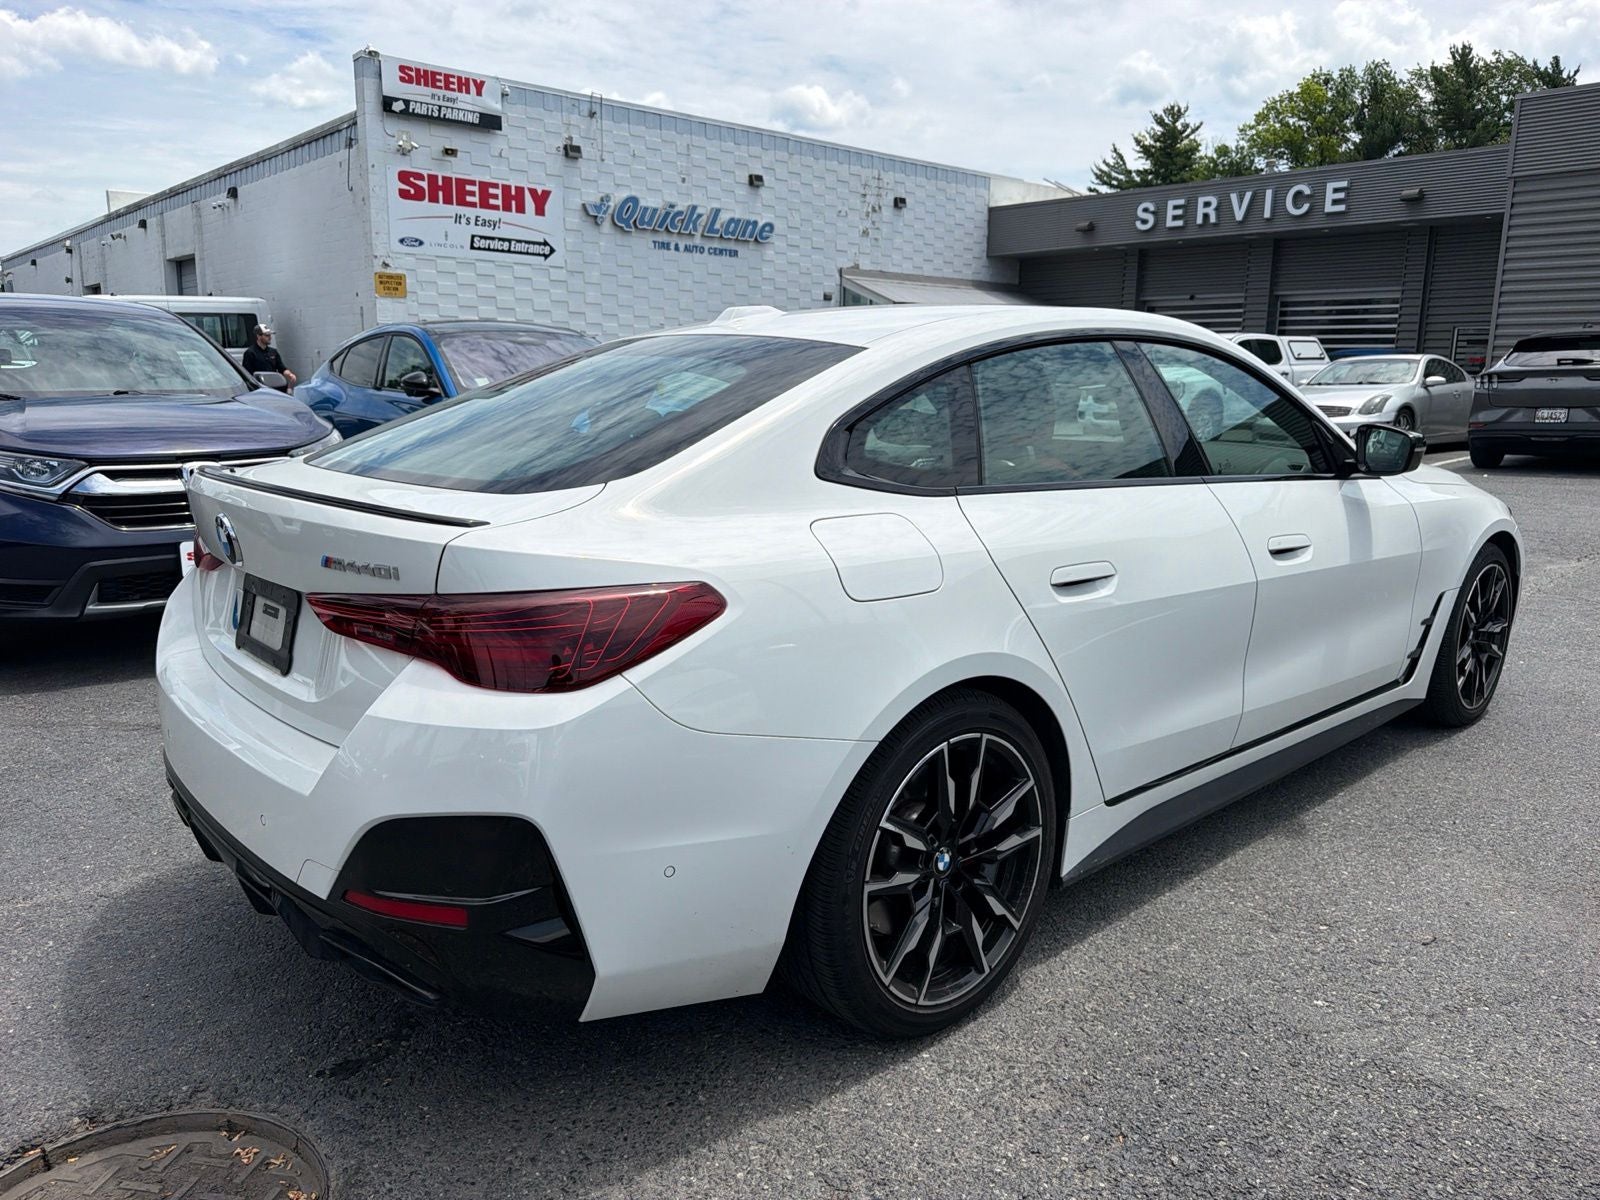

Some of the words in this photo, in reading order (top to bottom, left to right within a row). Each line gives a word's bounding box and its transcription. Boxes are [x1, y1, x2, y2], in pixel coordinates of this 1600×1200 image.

[398, 64, 486, 97] SHEEHY
[431, 93, 441, 101] It's
[442, 94, 459, 105] Easy!
[409, 101, 439, 118] PARTS
[440, 104, 480, 124] PARKING
[397, 170, 552, 217] SHEEHY
[1135, 180, 1348, 231] SERVICE
[454, 213, 472, 226] It's
[474, 215, 502, 230] Easy!
[613, 195, 702, 234] Quick
[704, 207, 775, 243] Lane
[401, 237, 421, 247] Ford
[429, 241, 465, 249] LINCOLN
[473, 236, 509, 251] Service
[510, 240, 550, 255] Entrance
[652, 240, 671, 251] TIRE
[674, 243, 680, 252] &
[683, 244, 705, 255] AUTO
[707, 246, 739, 258] CENTER
